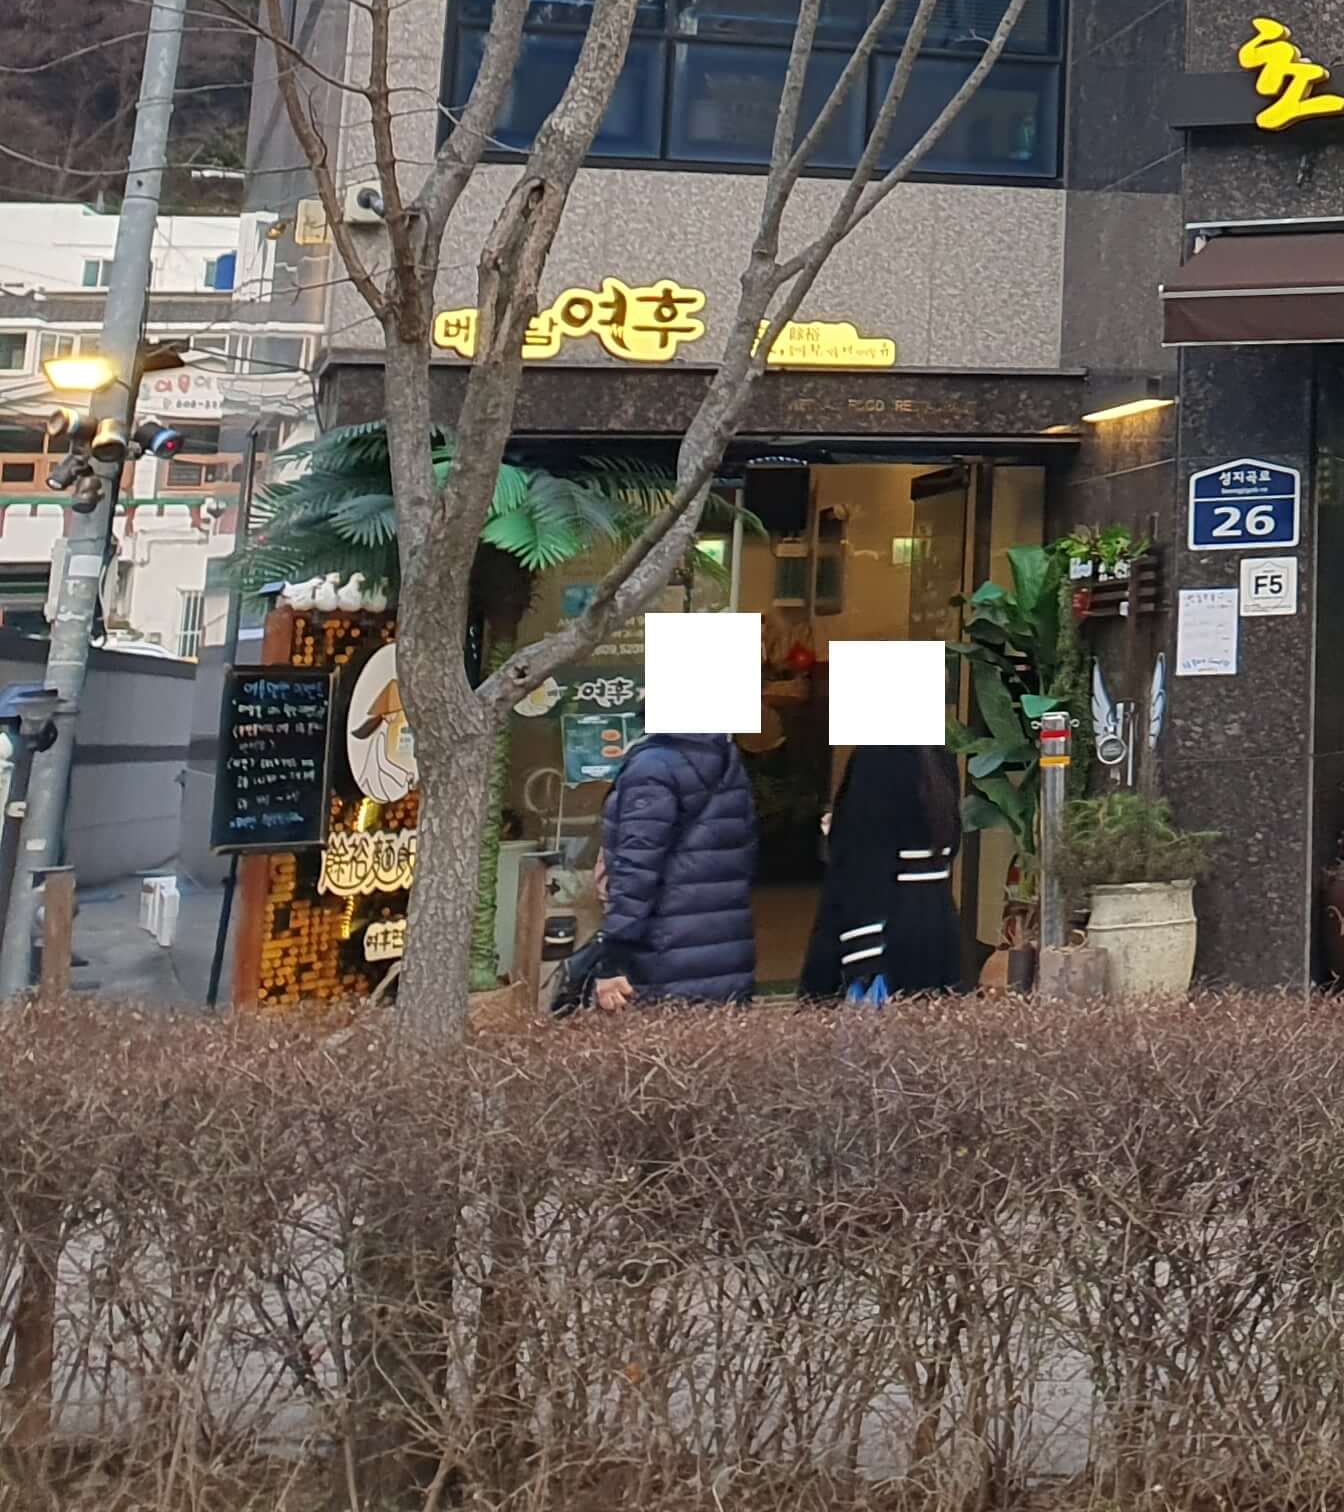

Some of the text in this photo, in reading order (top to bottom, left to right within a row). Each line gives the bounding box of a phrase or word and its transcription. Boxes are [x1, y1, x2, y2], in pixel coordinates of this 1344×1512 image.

[1219, 470, 1272, 486] 성지곡로
[1212, 505, 1276, 537] 26
[1253, 574, 1283, 595] F5
